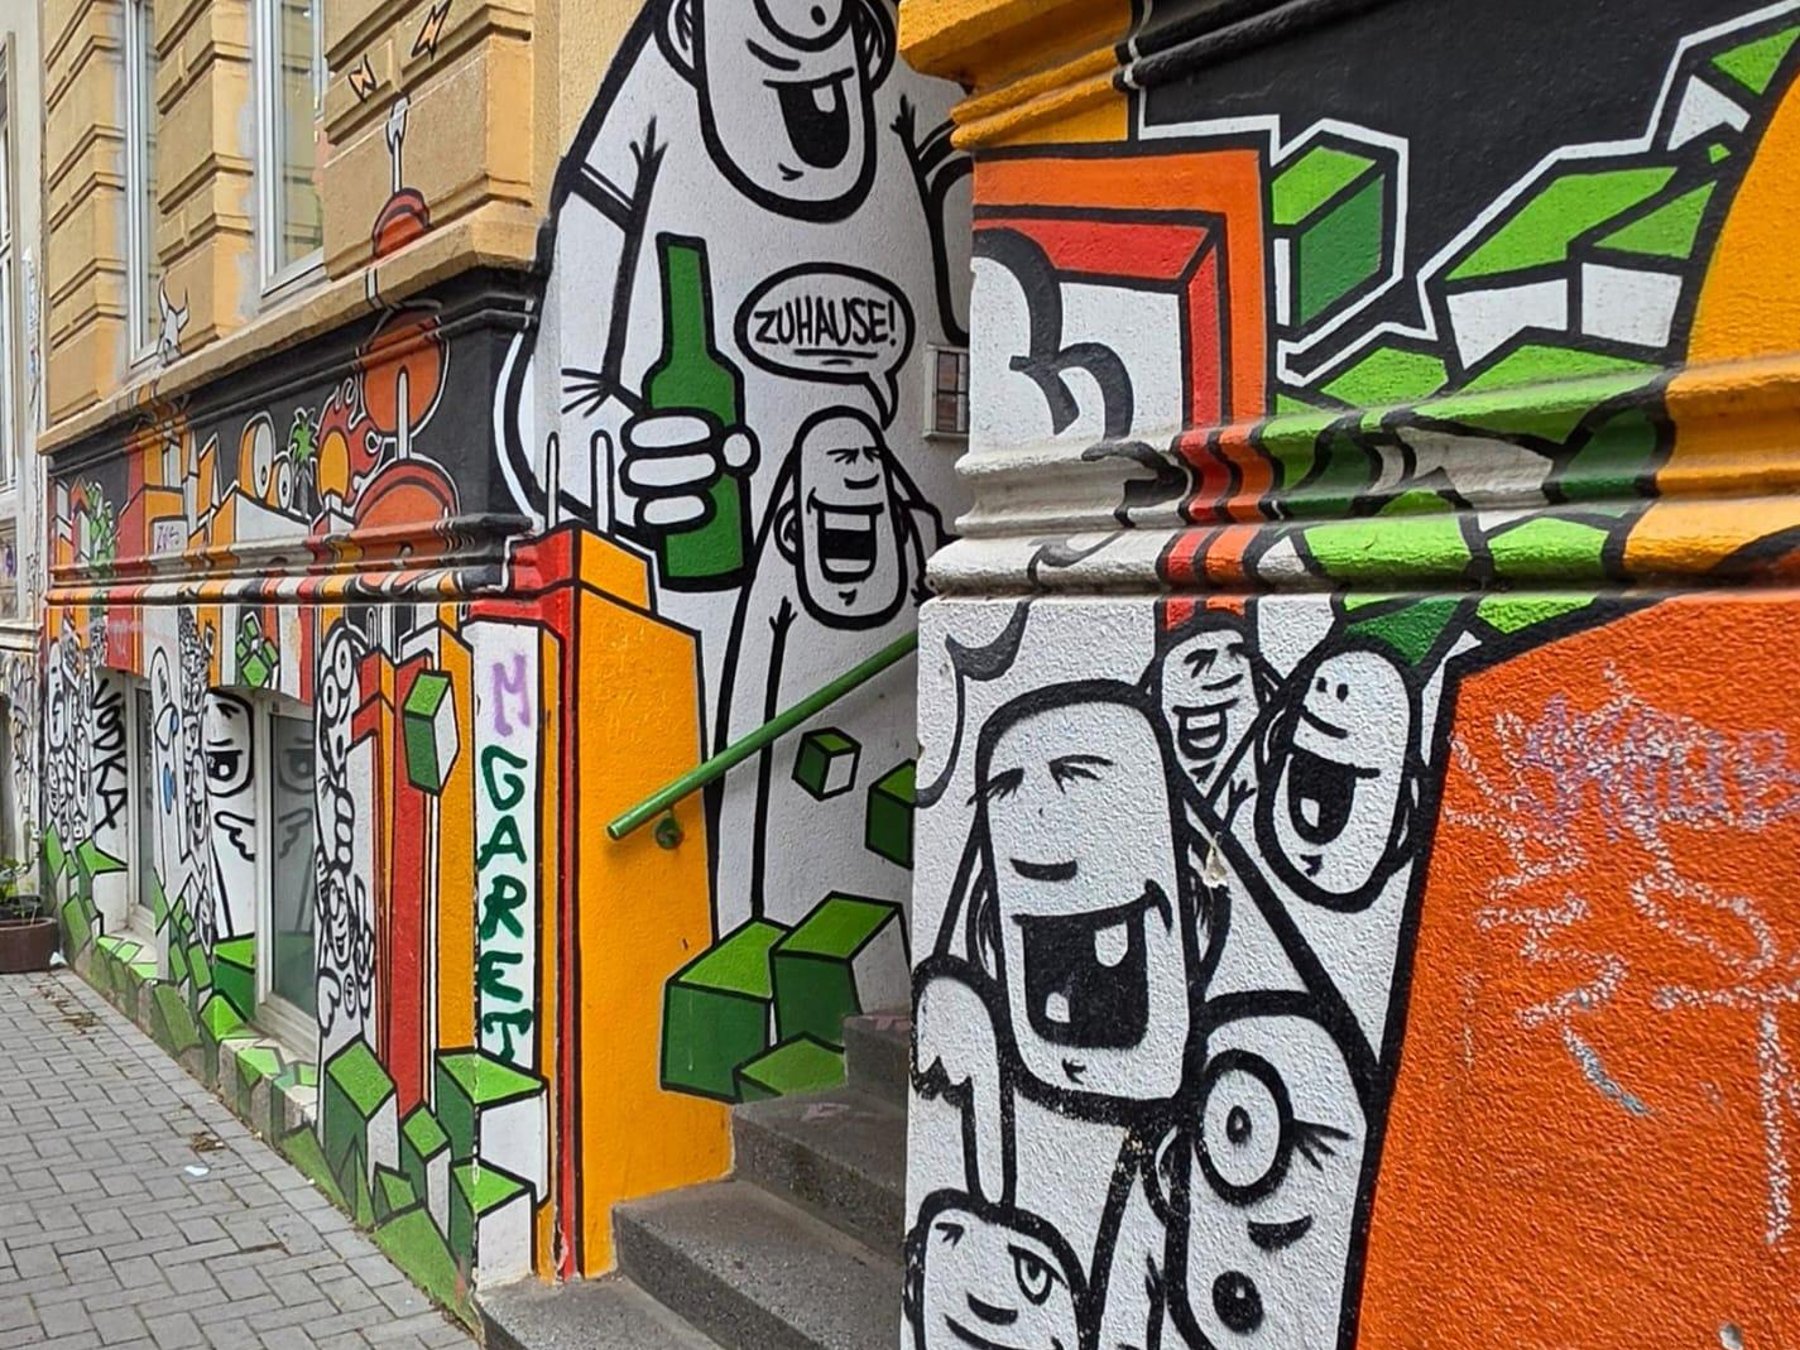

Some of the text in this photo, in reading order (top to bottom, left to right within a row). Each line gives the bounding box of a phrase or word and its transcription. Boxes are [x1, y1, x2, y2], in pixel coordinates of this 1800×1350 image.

[754, 295, 897, 347] ZUHAUSE!
[91, 678, 128, 833] VODKA
[478, 744, 534, 1062] GARET
